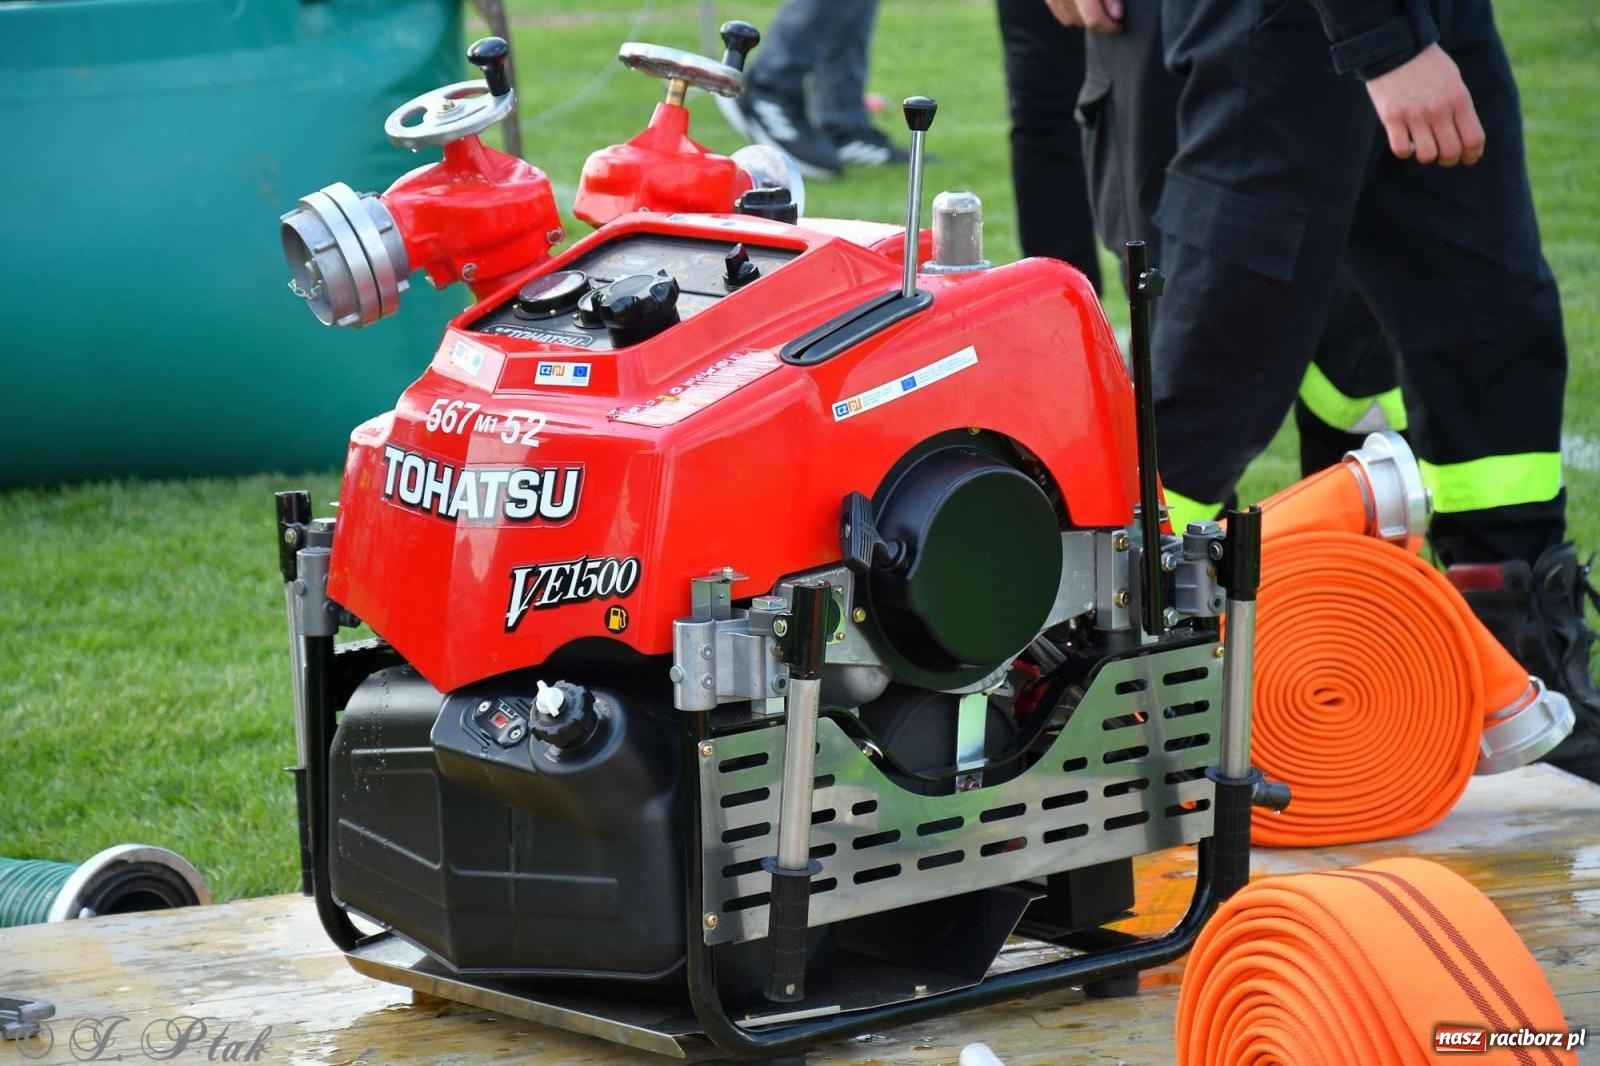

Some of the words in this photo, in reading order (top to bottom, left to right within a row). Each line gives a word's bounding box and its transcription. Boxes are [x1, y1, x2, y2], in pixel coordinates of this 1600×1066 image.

[426, 398, 481, 434] 567
[473, 414, 498, 434] M1
[500, 410, 546, 448] 52
[384, 445, 580, 520] TOHATSU
[505, 557, 639, 628] VE1500
